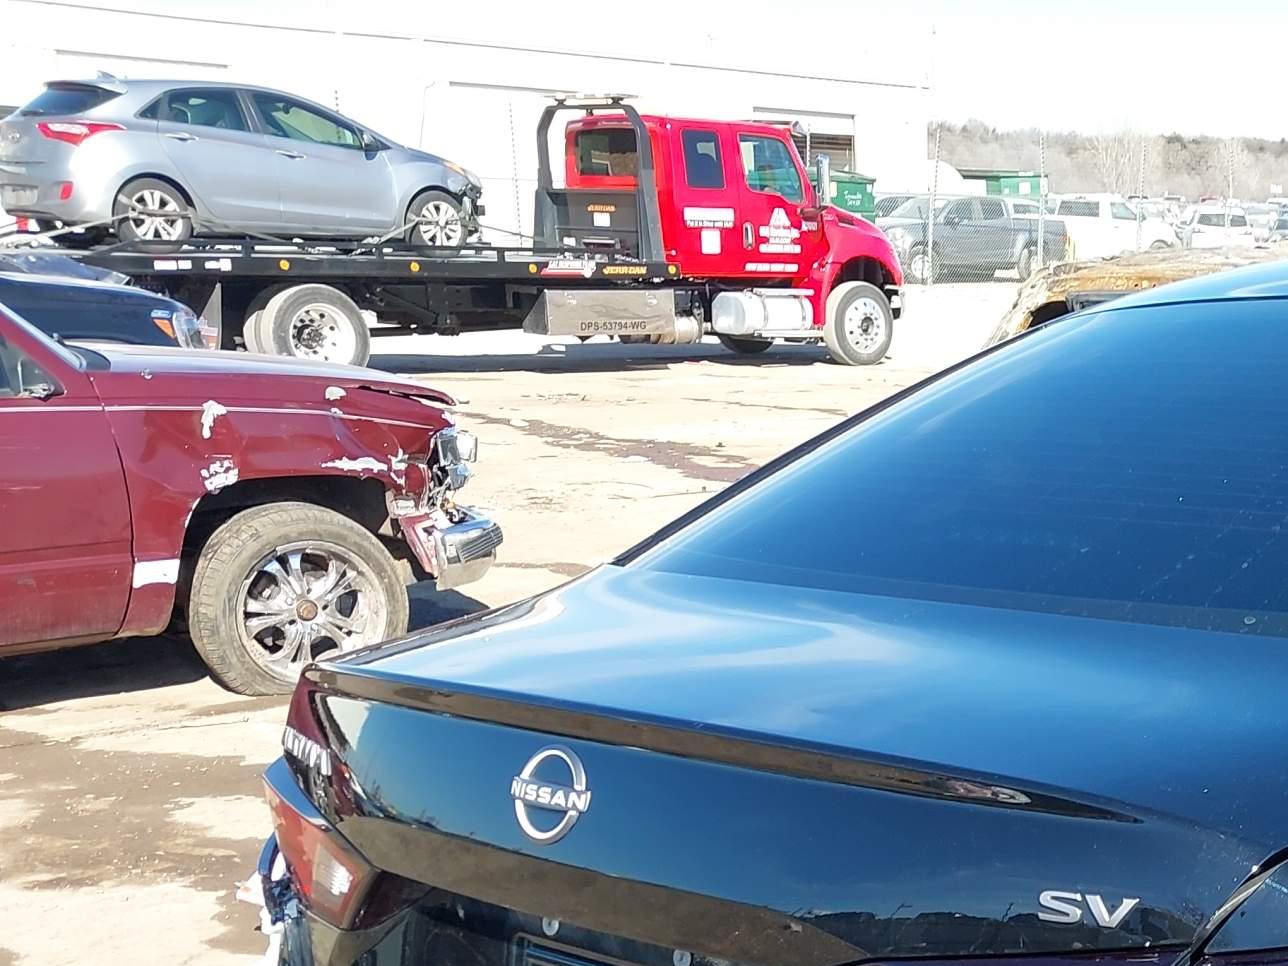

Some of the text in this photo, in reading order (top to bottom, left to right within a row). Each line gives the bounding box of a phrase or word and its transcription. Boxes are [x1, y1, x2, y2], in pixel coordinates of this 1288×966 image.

[580, 321, 647, 331] DPS-53794-WG
[510, 779, 588, 813] NISSAN
[1037, 890, 1140, 928] SV
